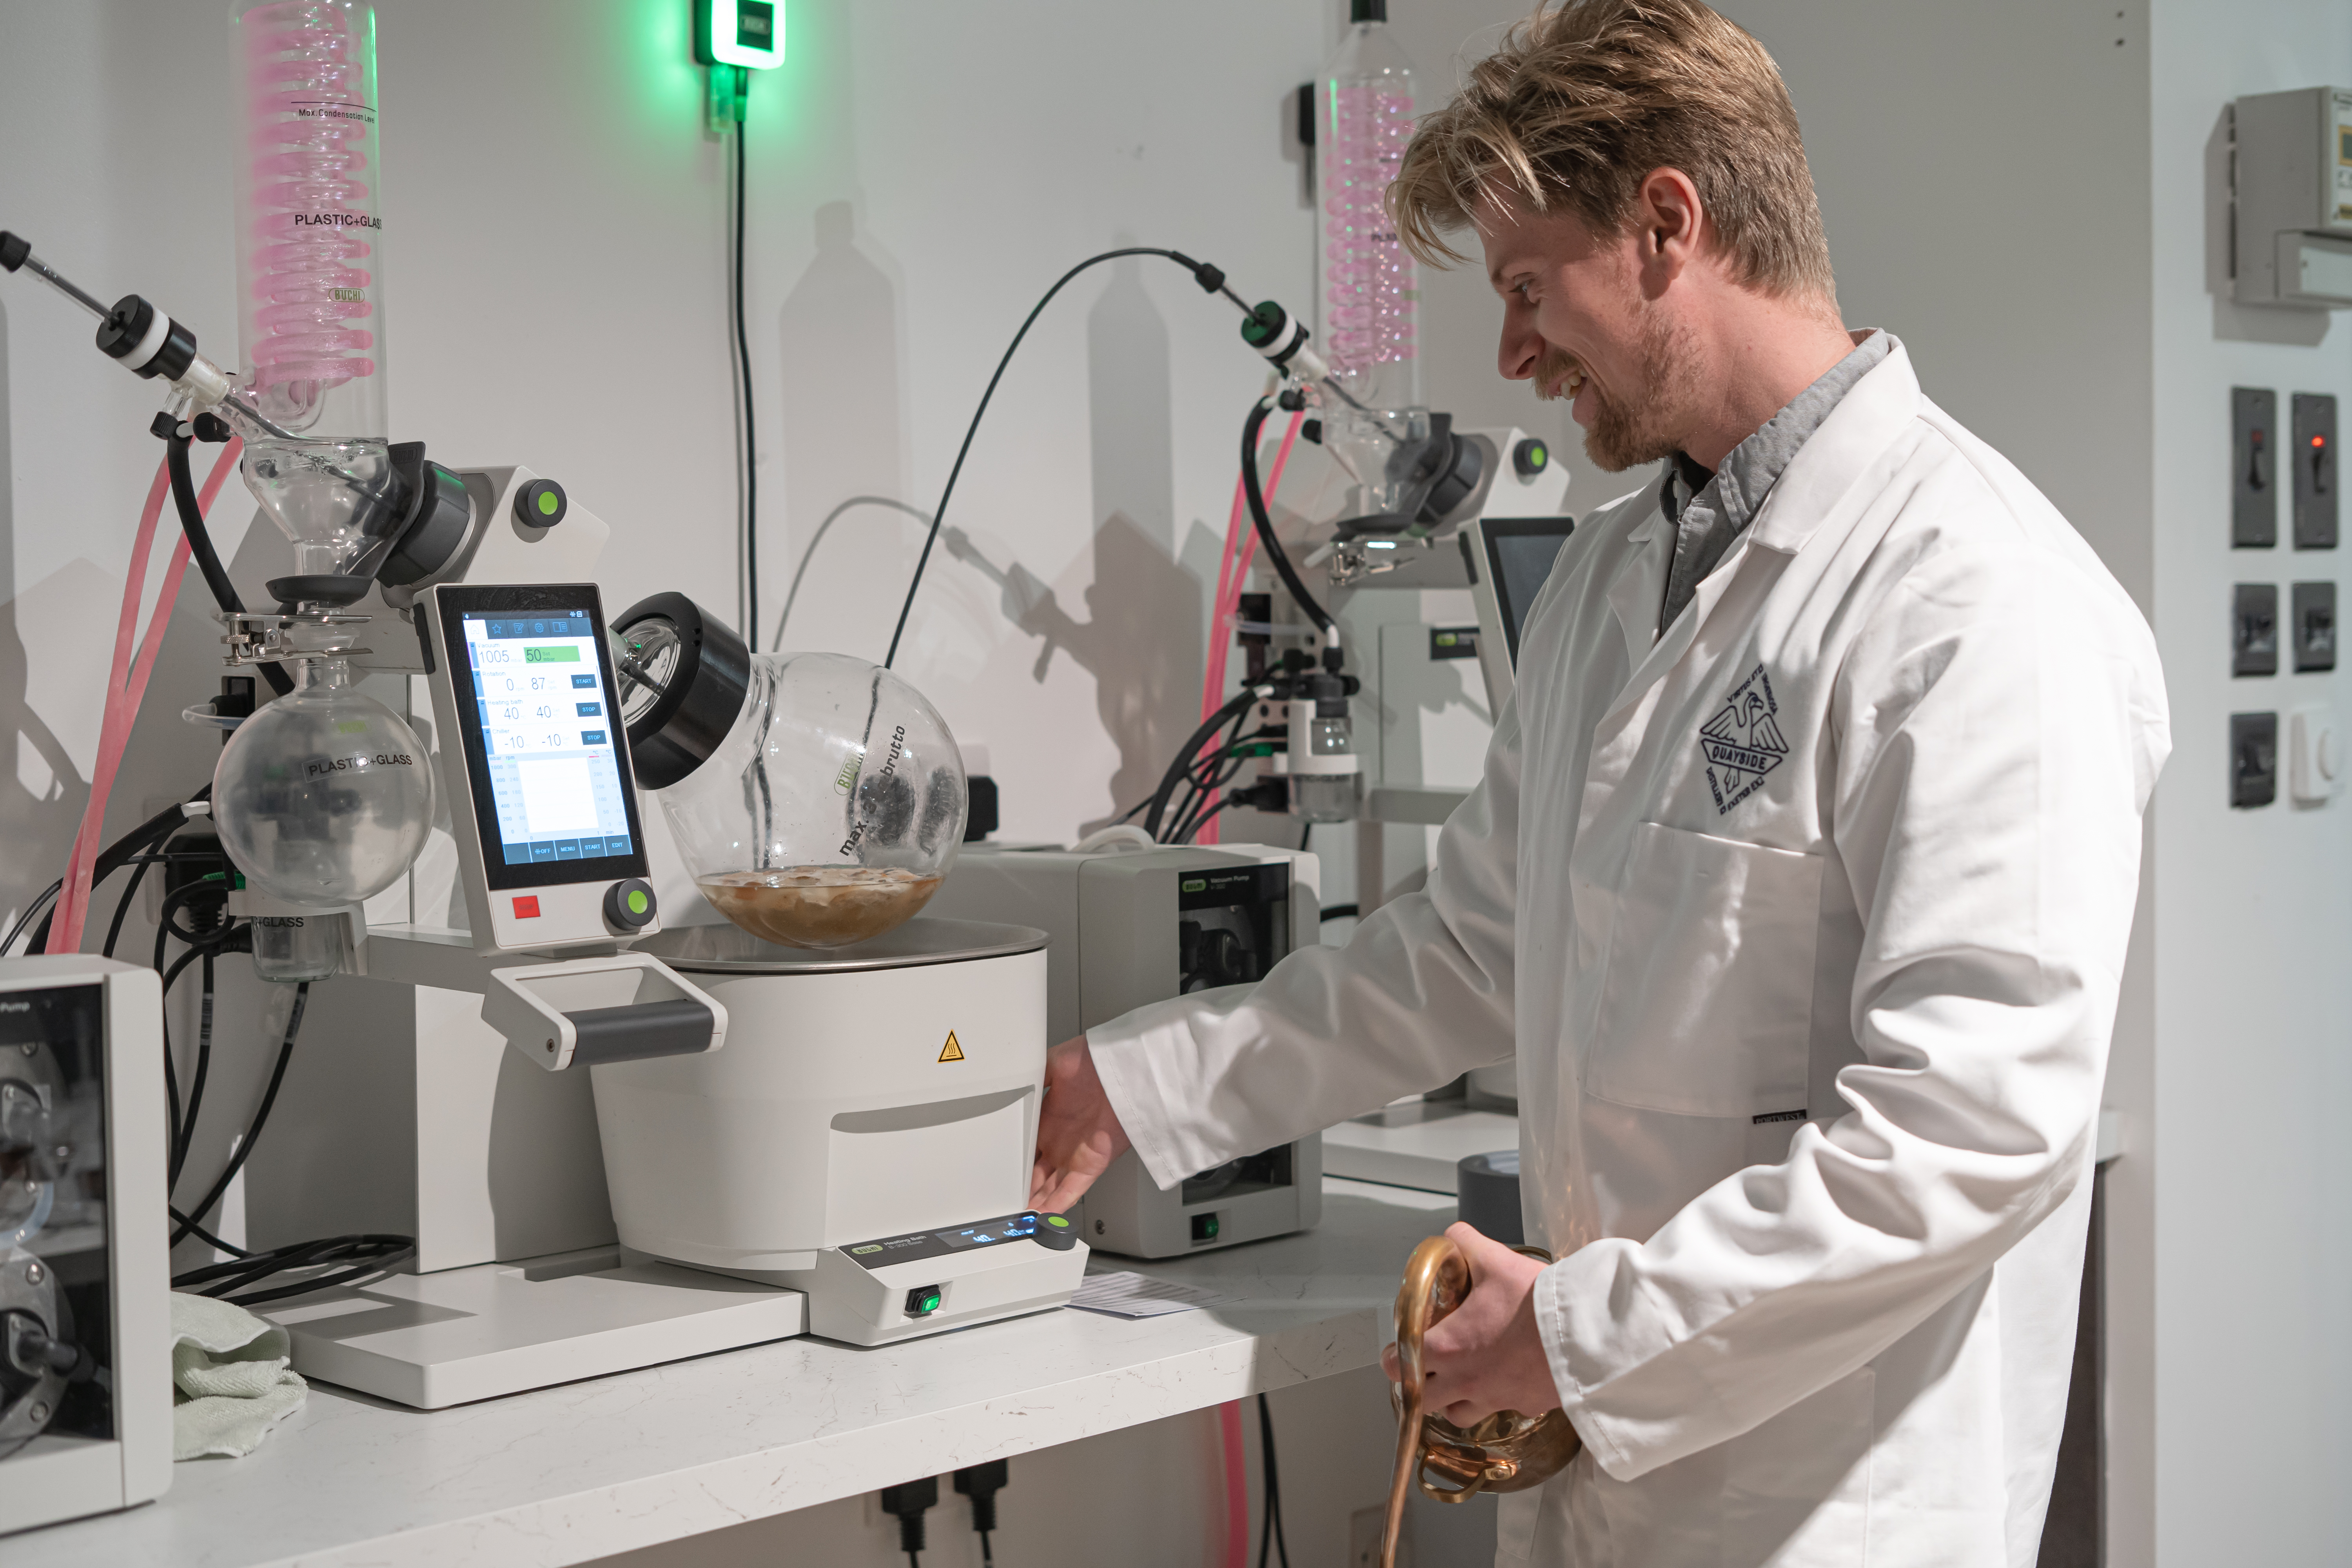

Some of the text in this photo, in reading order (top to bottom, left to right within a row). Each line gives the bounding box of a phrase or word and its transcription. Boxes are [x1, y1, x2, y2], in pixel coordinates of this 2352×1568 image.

[319, 109, 363, 121] Condensation
[365, 114, 375, 124] Level
[295, 214, 382, 230] PLASTIC+GLASS
[479, 650, 509, 663] 1005
[526, 648, 542, 662] 50
[506, 679, 514, 691] 0
[531, 677, 545, 690] 87
[504, 707, 519, 720] 40
[537, 706, 552, 719] 40
[505, 735, 524, 748] -10
[542, 734, 561, 746] -10
[1712, 745, 1767, 770] QUAYSIDE
[309, 754, 412, 777] PLASTIC+GLASS
[839, 820, 870, 857] max.
[880, 725, 906, 778] brutto
[883, 1238, 911, 1246] Heating
